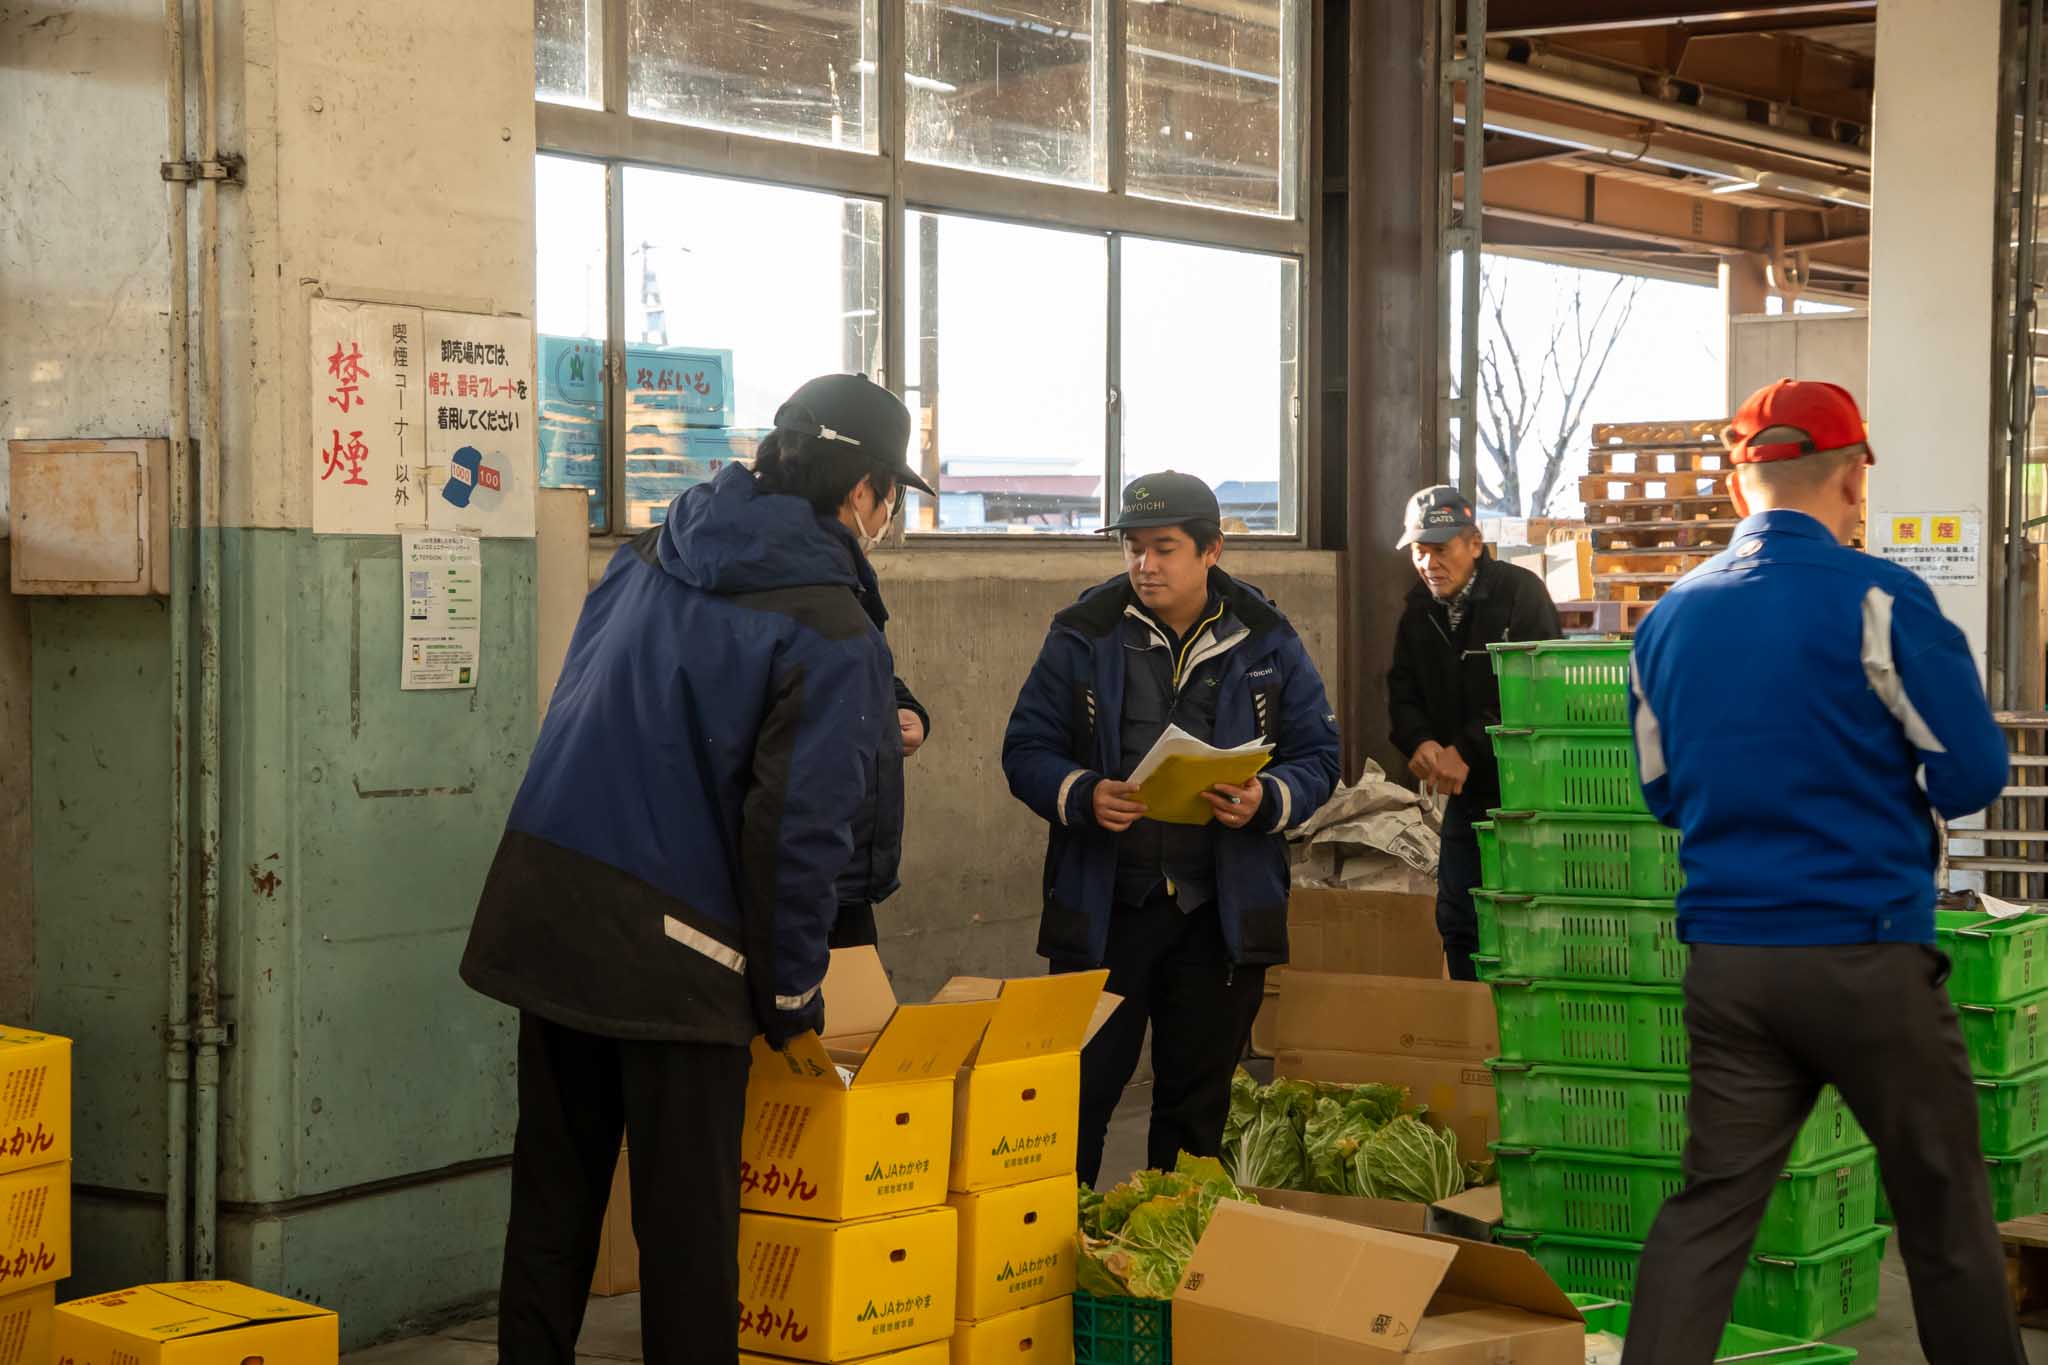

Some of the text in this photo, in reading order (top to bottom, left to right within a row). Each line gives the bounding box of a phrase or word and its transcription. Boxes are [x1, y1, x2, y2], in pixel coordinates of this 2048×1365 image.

[440, 339, 509, 367] 卸売場内では、
[320, 341, 370, 487] 禁煙
[392, 323, 410, 506] 喫煙コーナー以外
[437, 406, 520, 432] 着用してください
[451, 463, 472, 485] 1000
[479, 470, 499, 488] 100
[740, 1161, 818, 1202] みかん
